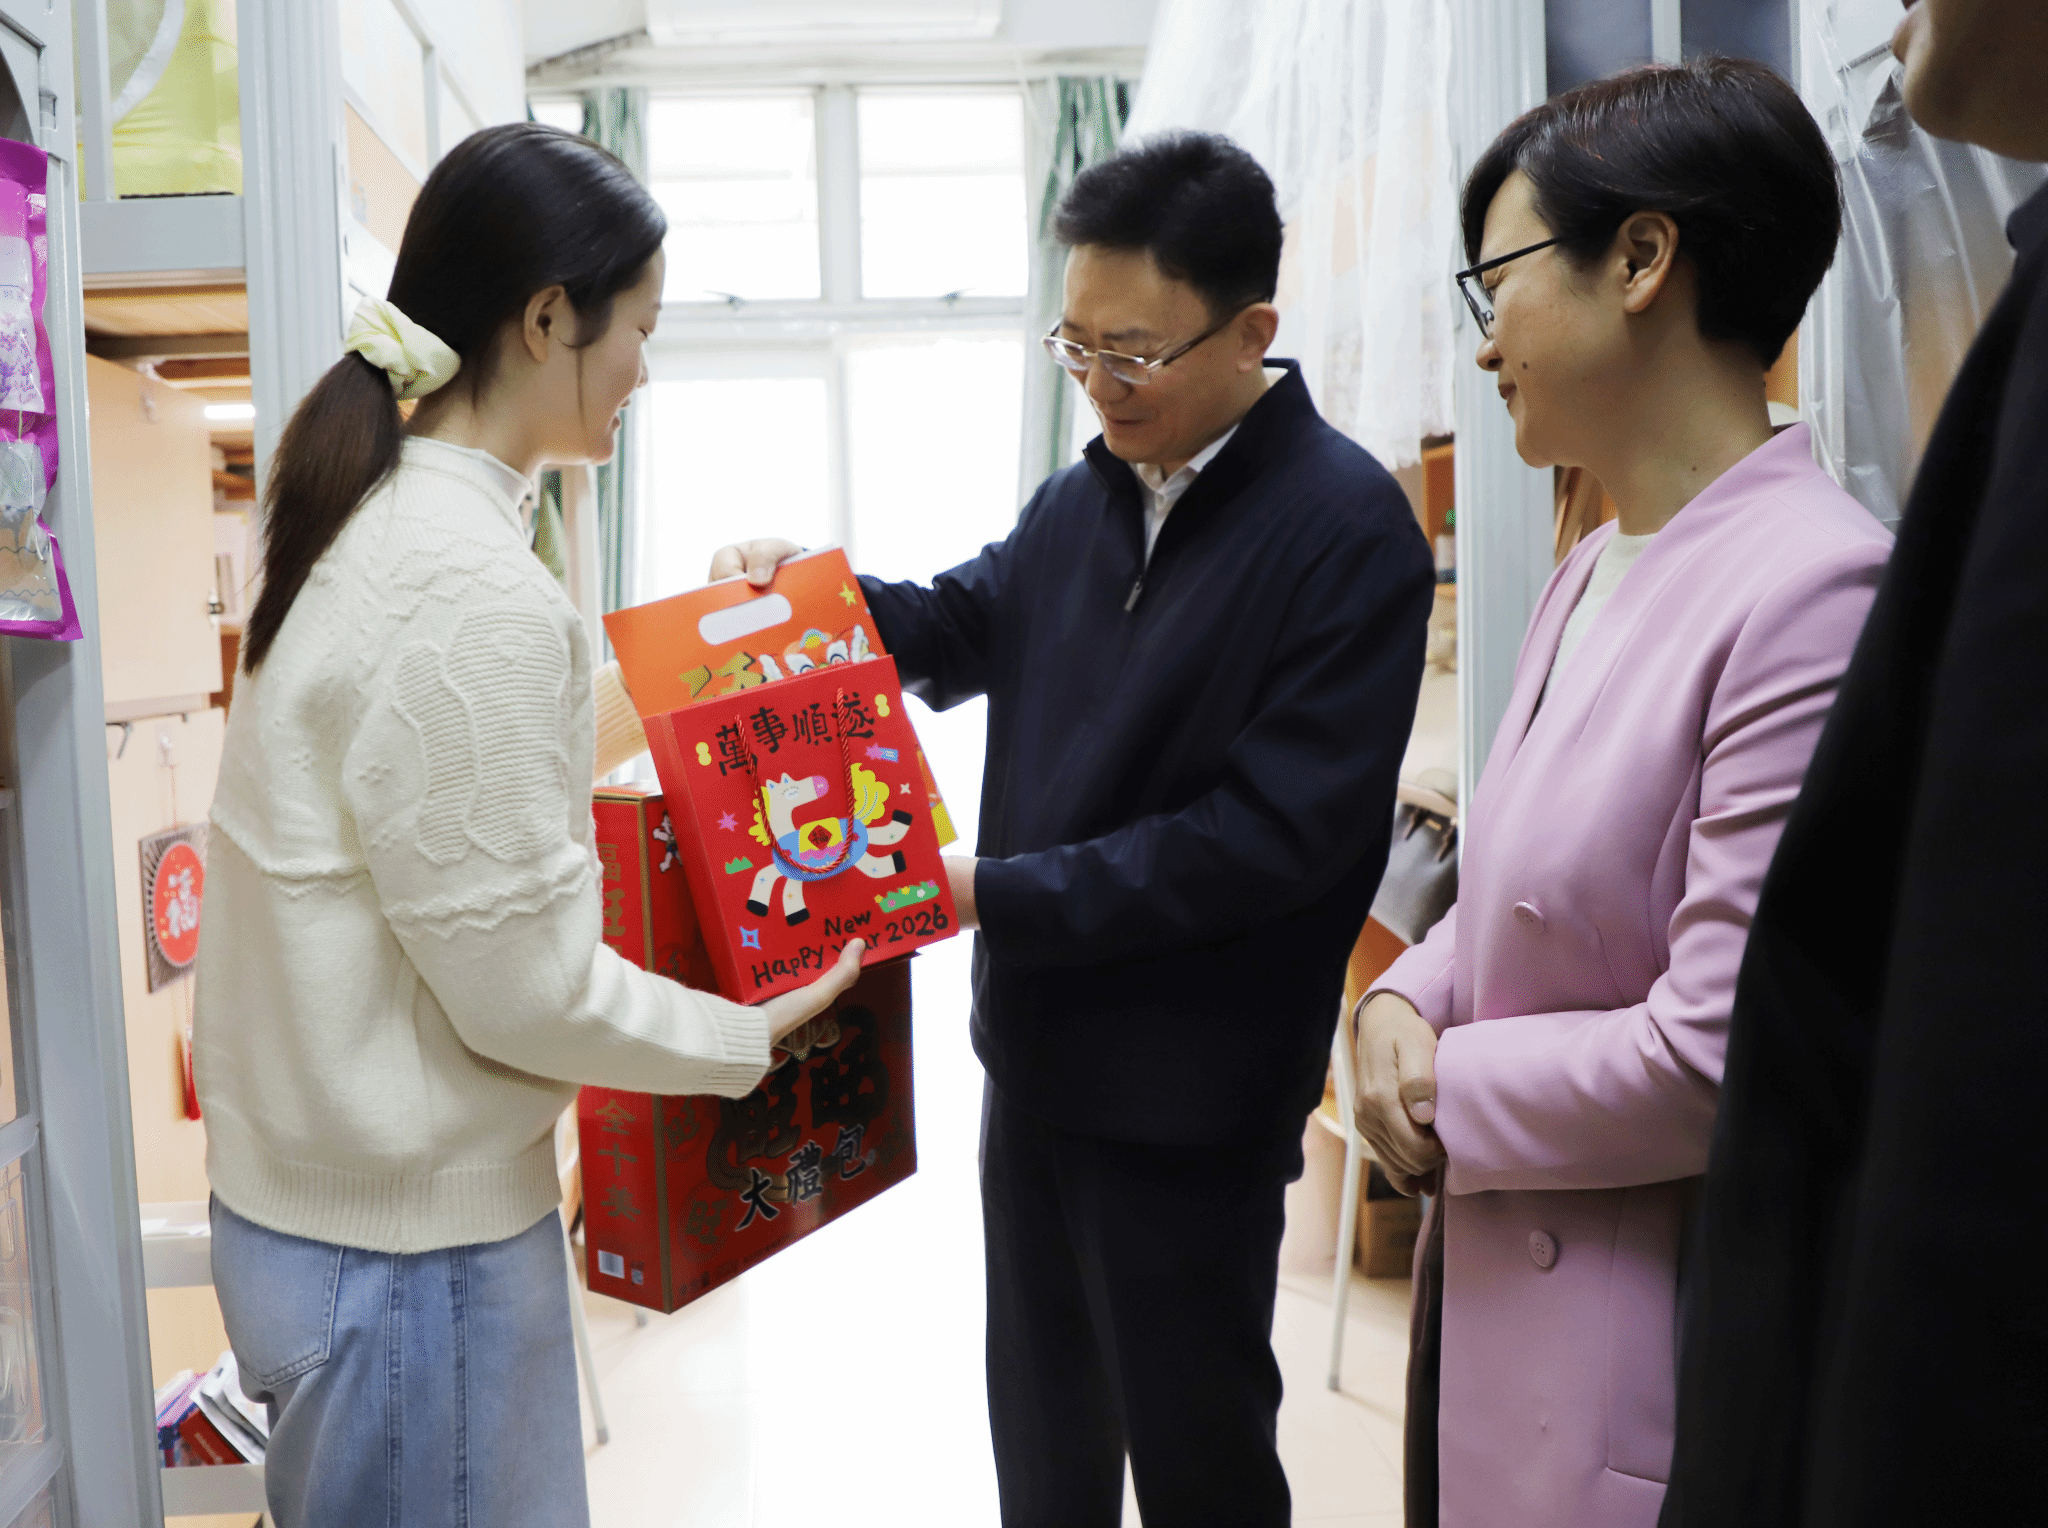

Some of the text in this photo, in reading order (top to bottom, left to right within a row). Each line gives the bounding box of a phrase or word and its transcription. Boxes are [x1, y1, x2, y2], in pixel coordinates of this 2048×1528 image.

[715, 691, 876, 777] 萬事順遂
[751, 944, 825, 988] Happy
[885, 903, 949, 943] 2026
[824, 910, 872, 938] New
[734, 1122, 868, 1233] 大禮包
